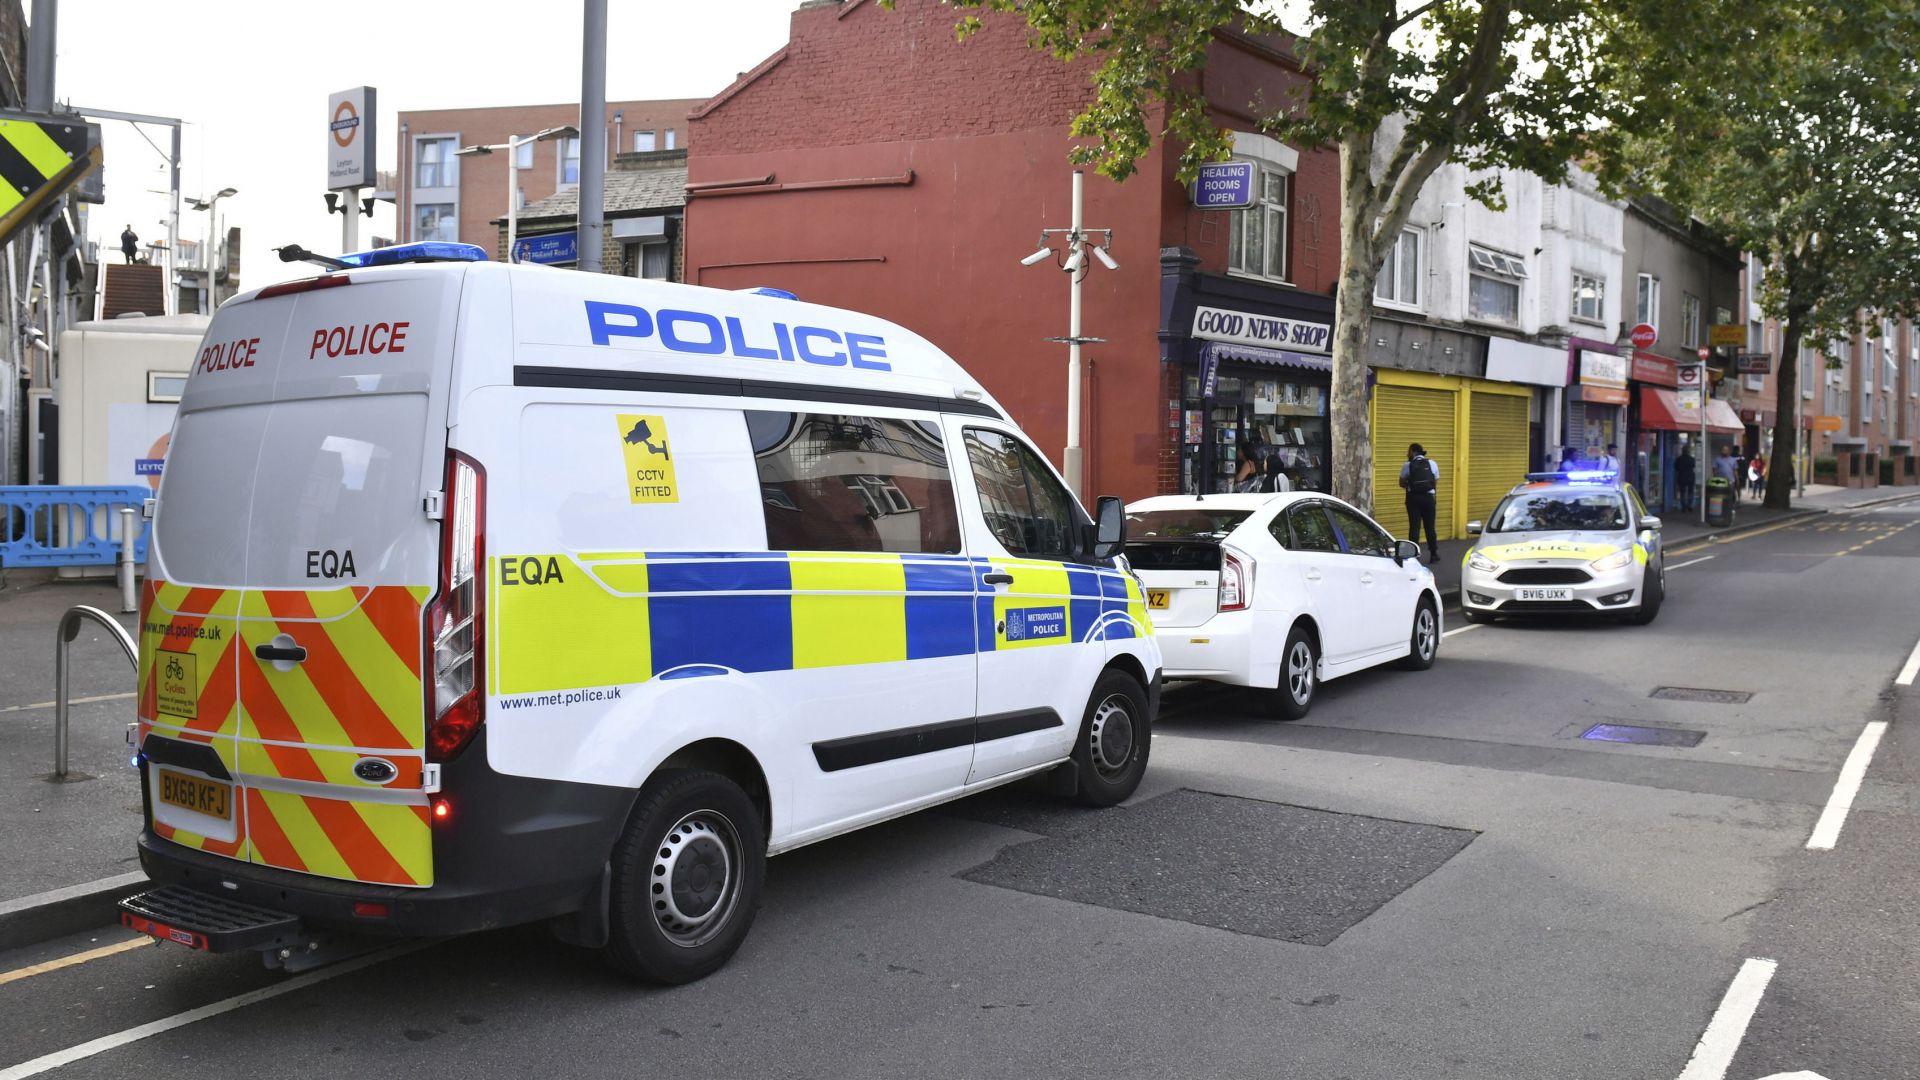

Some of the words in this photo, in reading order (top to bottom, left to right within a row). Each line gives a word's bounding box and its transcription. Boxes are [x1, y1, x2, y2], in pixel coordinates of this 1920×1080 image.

[336, 160, 353, 168] Leyton
[330, 169, 348, 177] Midland
[348, 167, 360, 175] Road
[1202, 167, 1245, 178] HEALING
[1204, 180, 1241, 190] ROOMS
[1208, 193, 1235, 203] OPEN
[540, 240, 560, 250] Leyton
[554, 247, 569, 256] Road
[1198, 310, 1243, 336] GOOD
[1245, 317, 1290, 342] NEWS
[1290, 323, 1328, 347] SHOP
[309, 322, 410, 360] POLICE
[584, 300, 892, 372] POLICE
[197, 338, 260, 375] POLICE
[636, 470, 665, 481] CCTV
[635, 486, 671, 498] FITTED
[306, 550, 357, 579] EQA
[500, 557, 564, 586] EQA
[1546, 589, 1566, 599] UXK
[1027, 612, 1064, 622] METROPOLITAN
[143, 623, 221, 641] www.met.police.uk
[1033, 624, 1060, 635] POLICE
[164, 682, 186, 695] Cyclists
[500, 687, 622, 711] www.met.police.uk
[164, 775, 195, 806] BX68
[199, 783, 225, 814] KFJ
